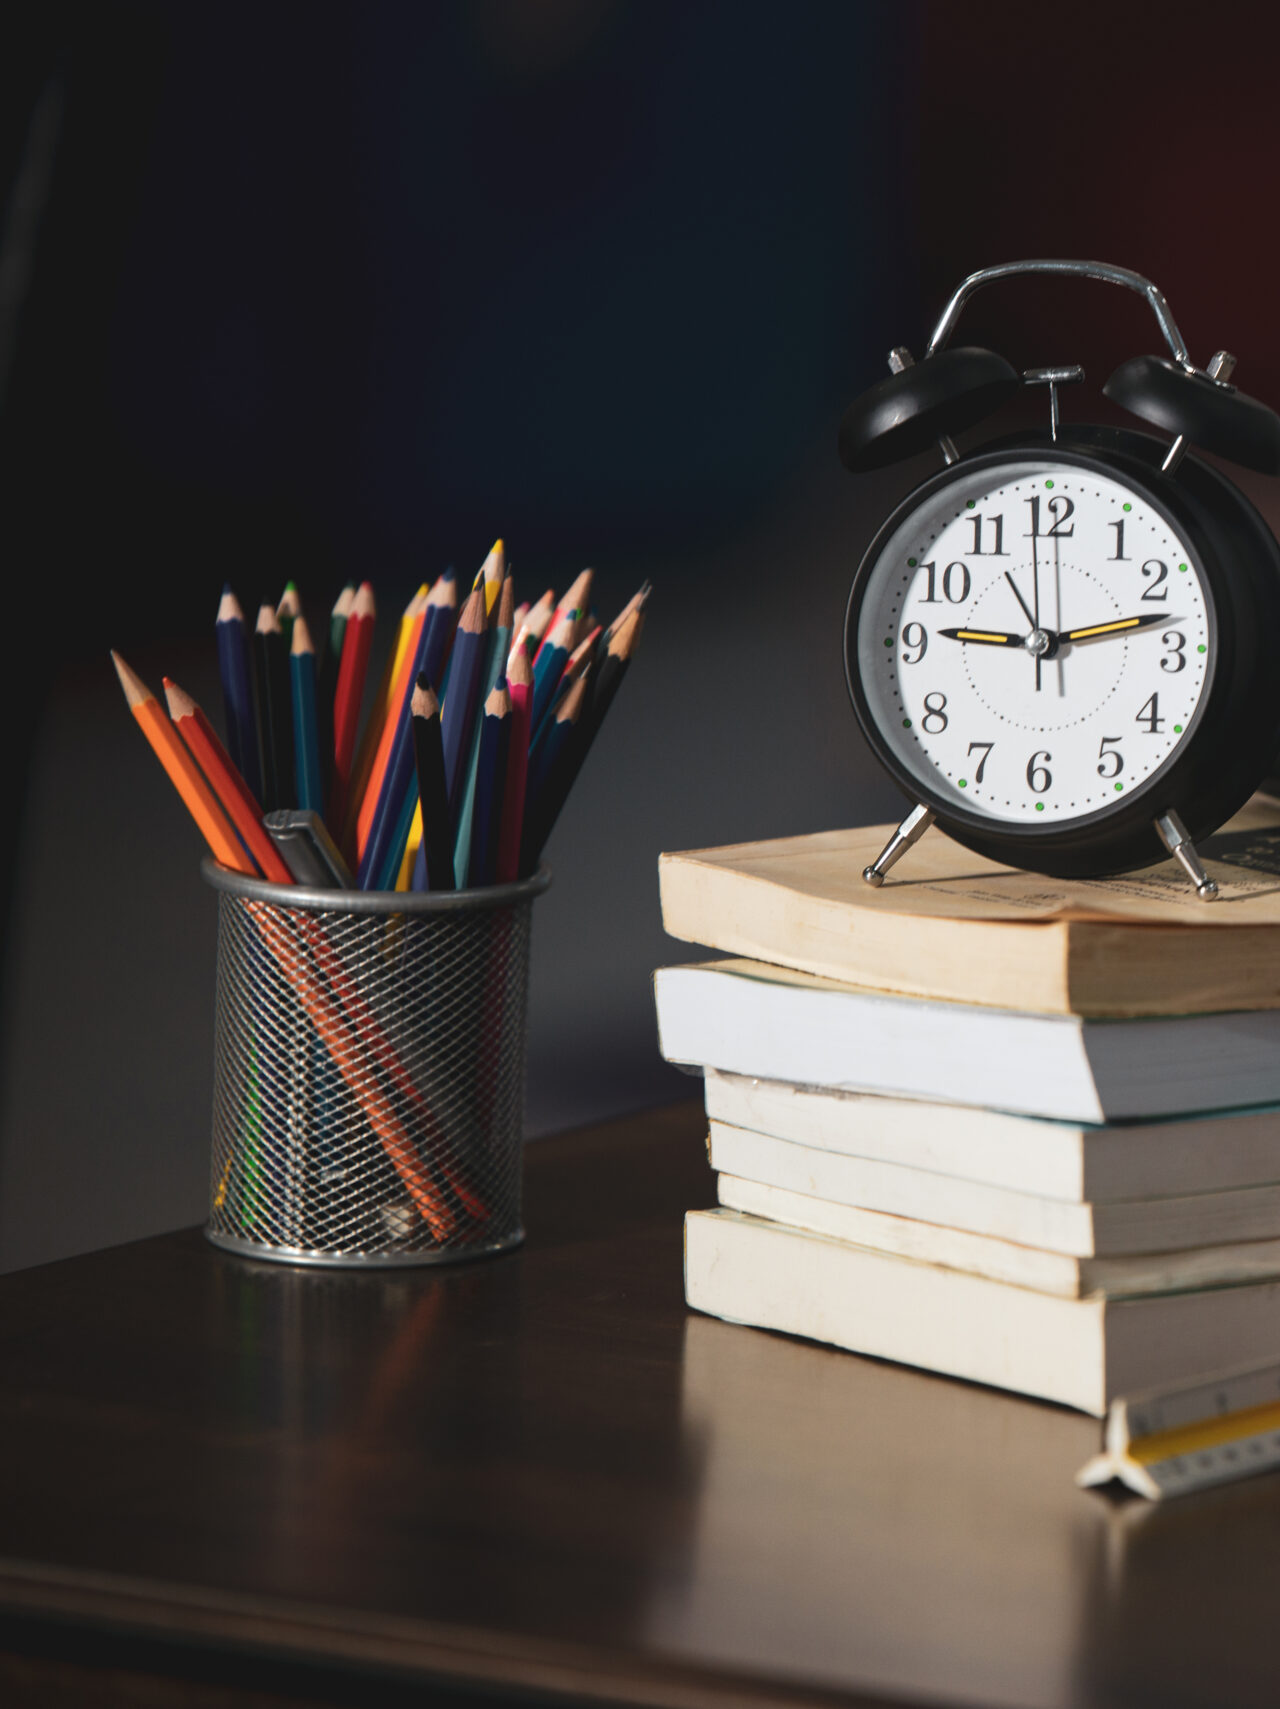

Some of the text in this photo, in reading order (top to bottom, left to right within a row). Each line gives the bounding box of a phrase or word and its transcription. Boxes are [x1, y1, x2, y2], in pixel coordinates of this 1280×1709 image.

[965, 513, 1011, 556] 11
[1023, 495, 1075, 537] 12
[1107, 519, 1132, 561] 1
[918, 560, 971, 604] 10
[1140, 559, 1168, 601] 2
[902, 622, 928, 664] 9
[1160, 630, 1187, 673] 3
[921, 692, 948, 734] 8
[1135, 691, 1165, 734] 4
[967, 742, 995, 784] 7
[1026, 751, 1052, 793] 6
[1097, 736, 1124, 779] 5
